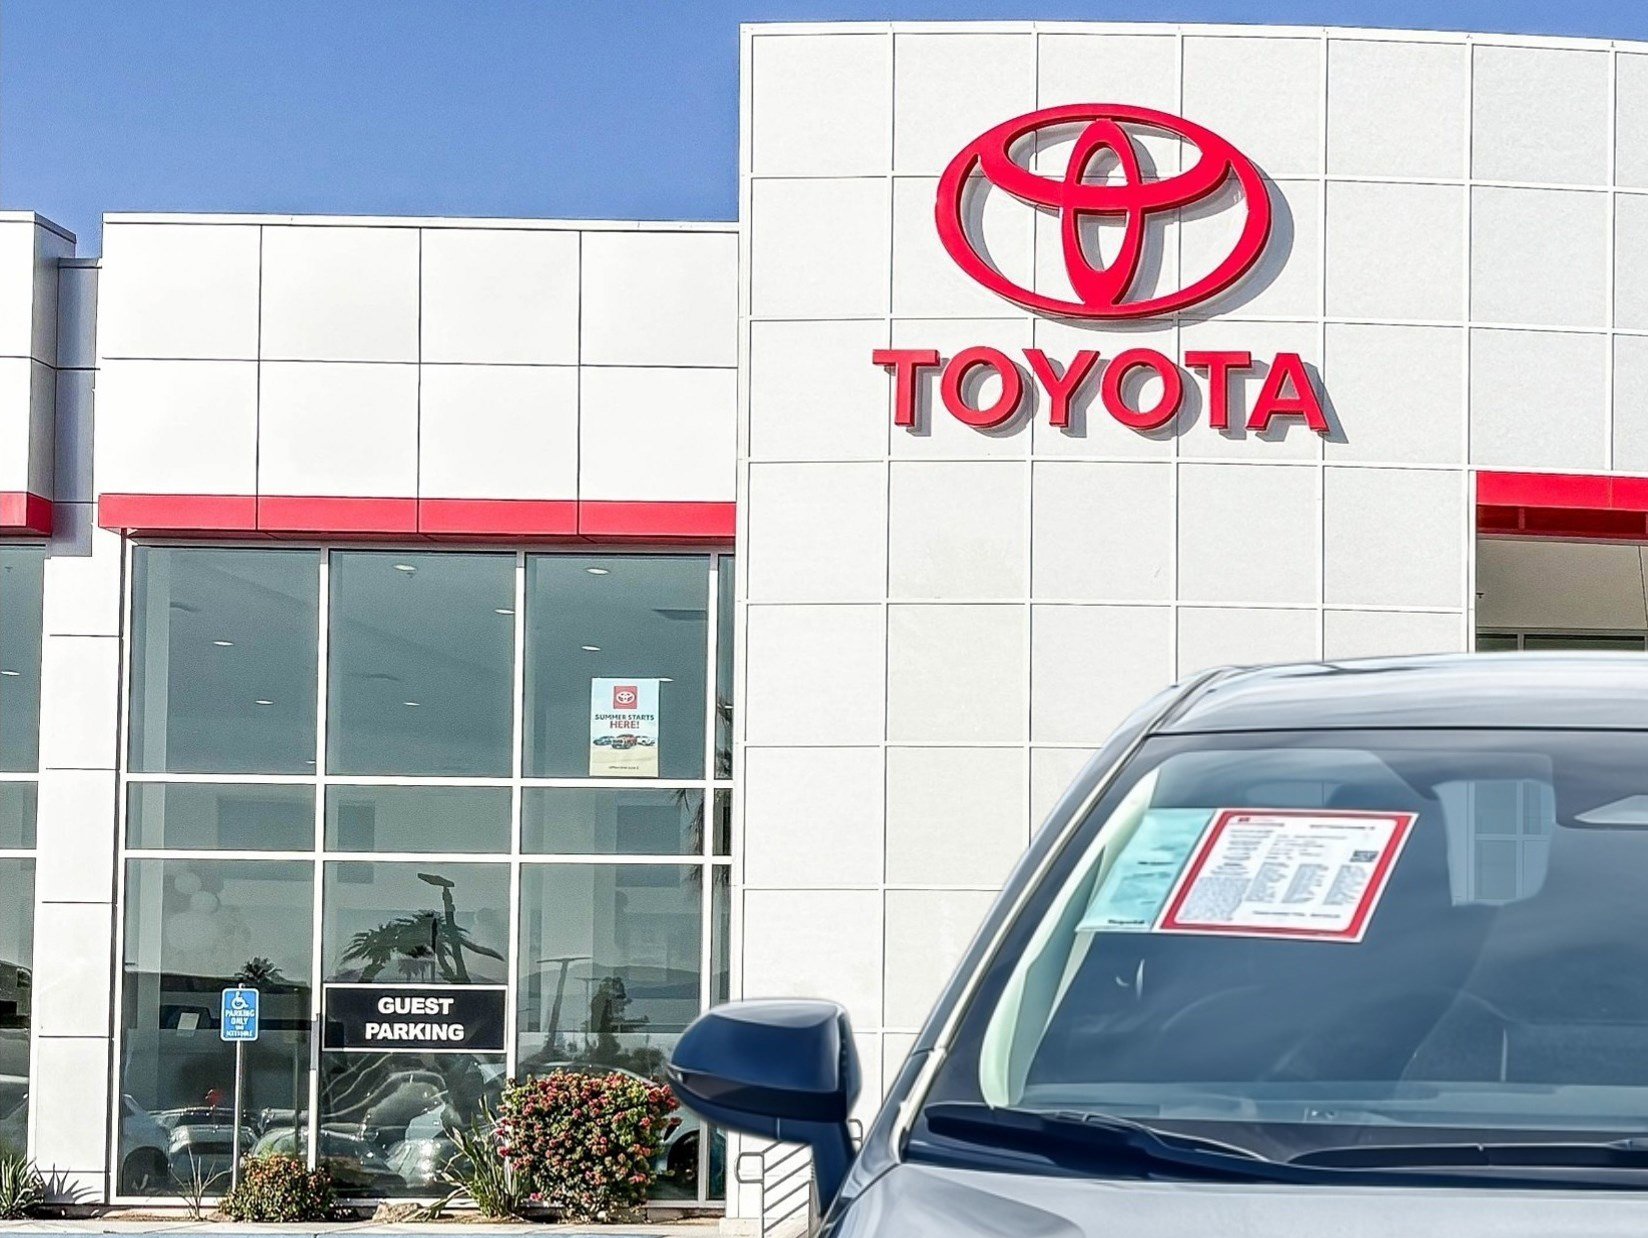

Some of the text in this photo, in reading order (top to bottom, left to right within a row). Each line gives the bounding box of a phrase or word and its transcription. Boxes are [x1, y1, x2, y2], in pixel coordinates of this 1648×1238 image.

[872, 345, 1330, 432] TOYOTA
[609, 720, 640, 729] HERE!
[377, 996, 455, 1015] GUEST
[364, 1022, 465, 1041] PARKING
